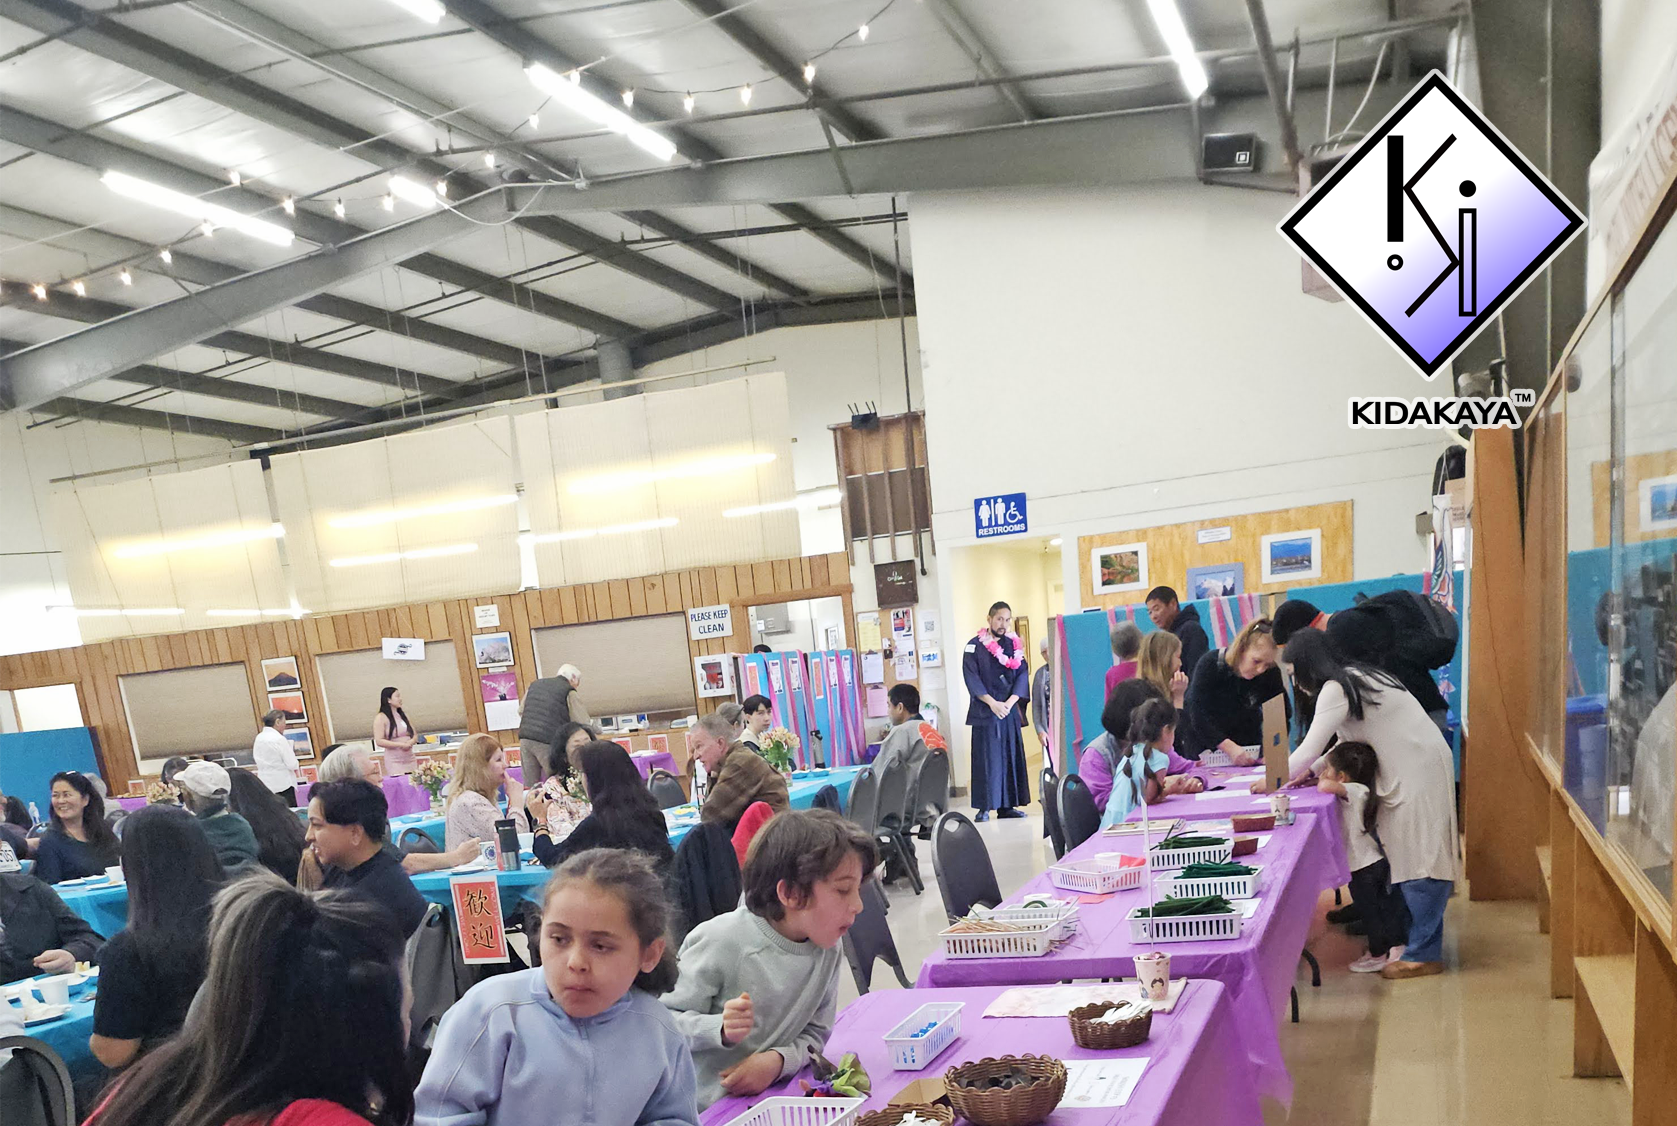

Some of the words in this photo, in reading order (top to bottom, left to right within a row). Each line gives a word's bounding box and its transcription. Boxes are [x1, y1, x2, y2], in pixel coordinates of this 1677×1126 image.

[978, 523, 1026, 536] RESTROOMS
[690, 612, 712, 622] PLEASE
[713, 609, 728, 619] KEEP
[698, 623, 725, 634] CLEAN
